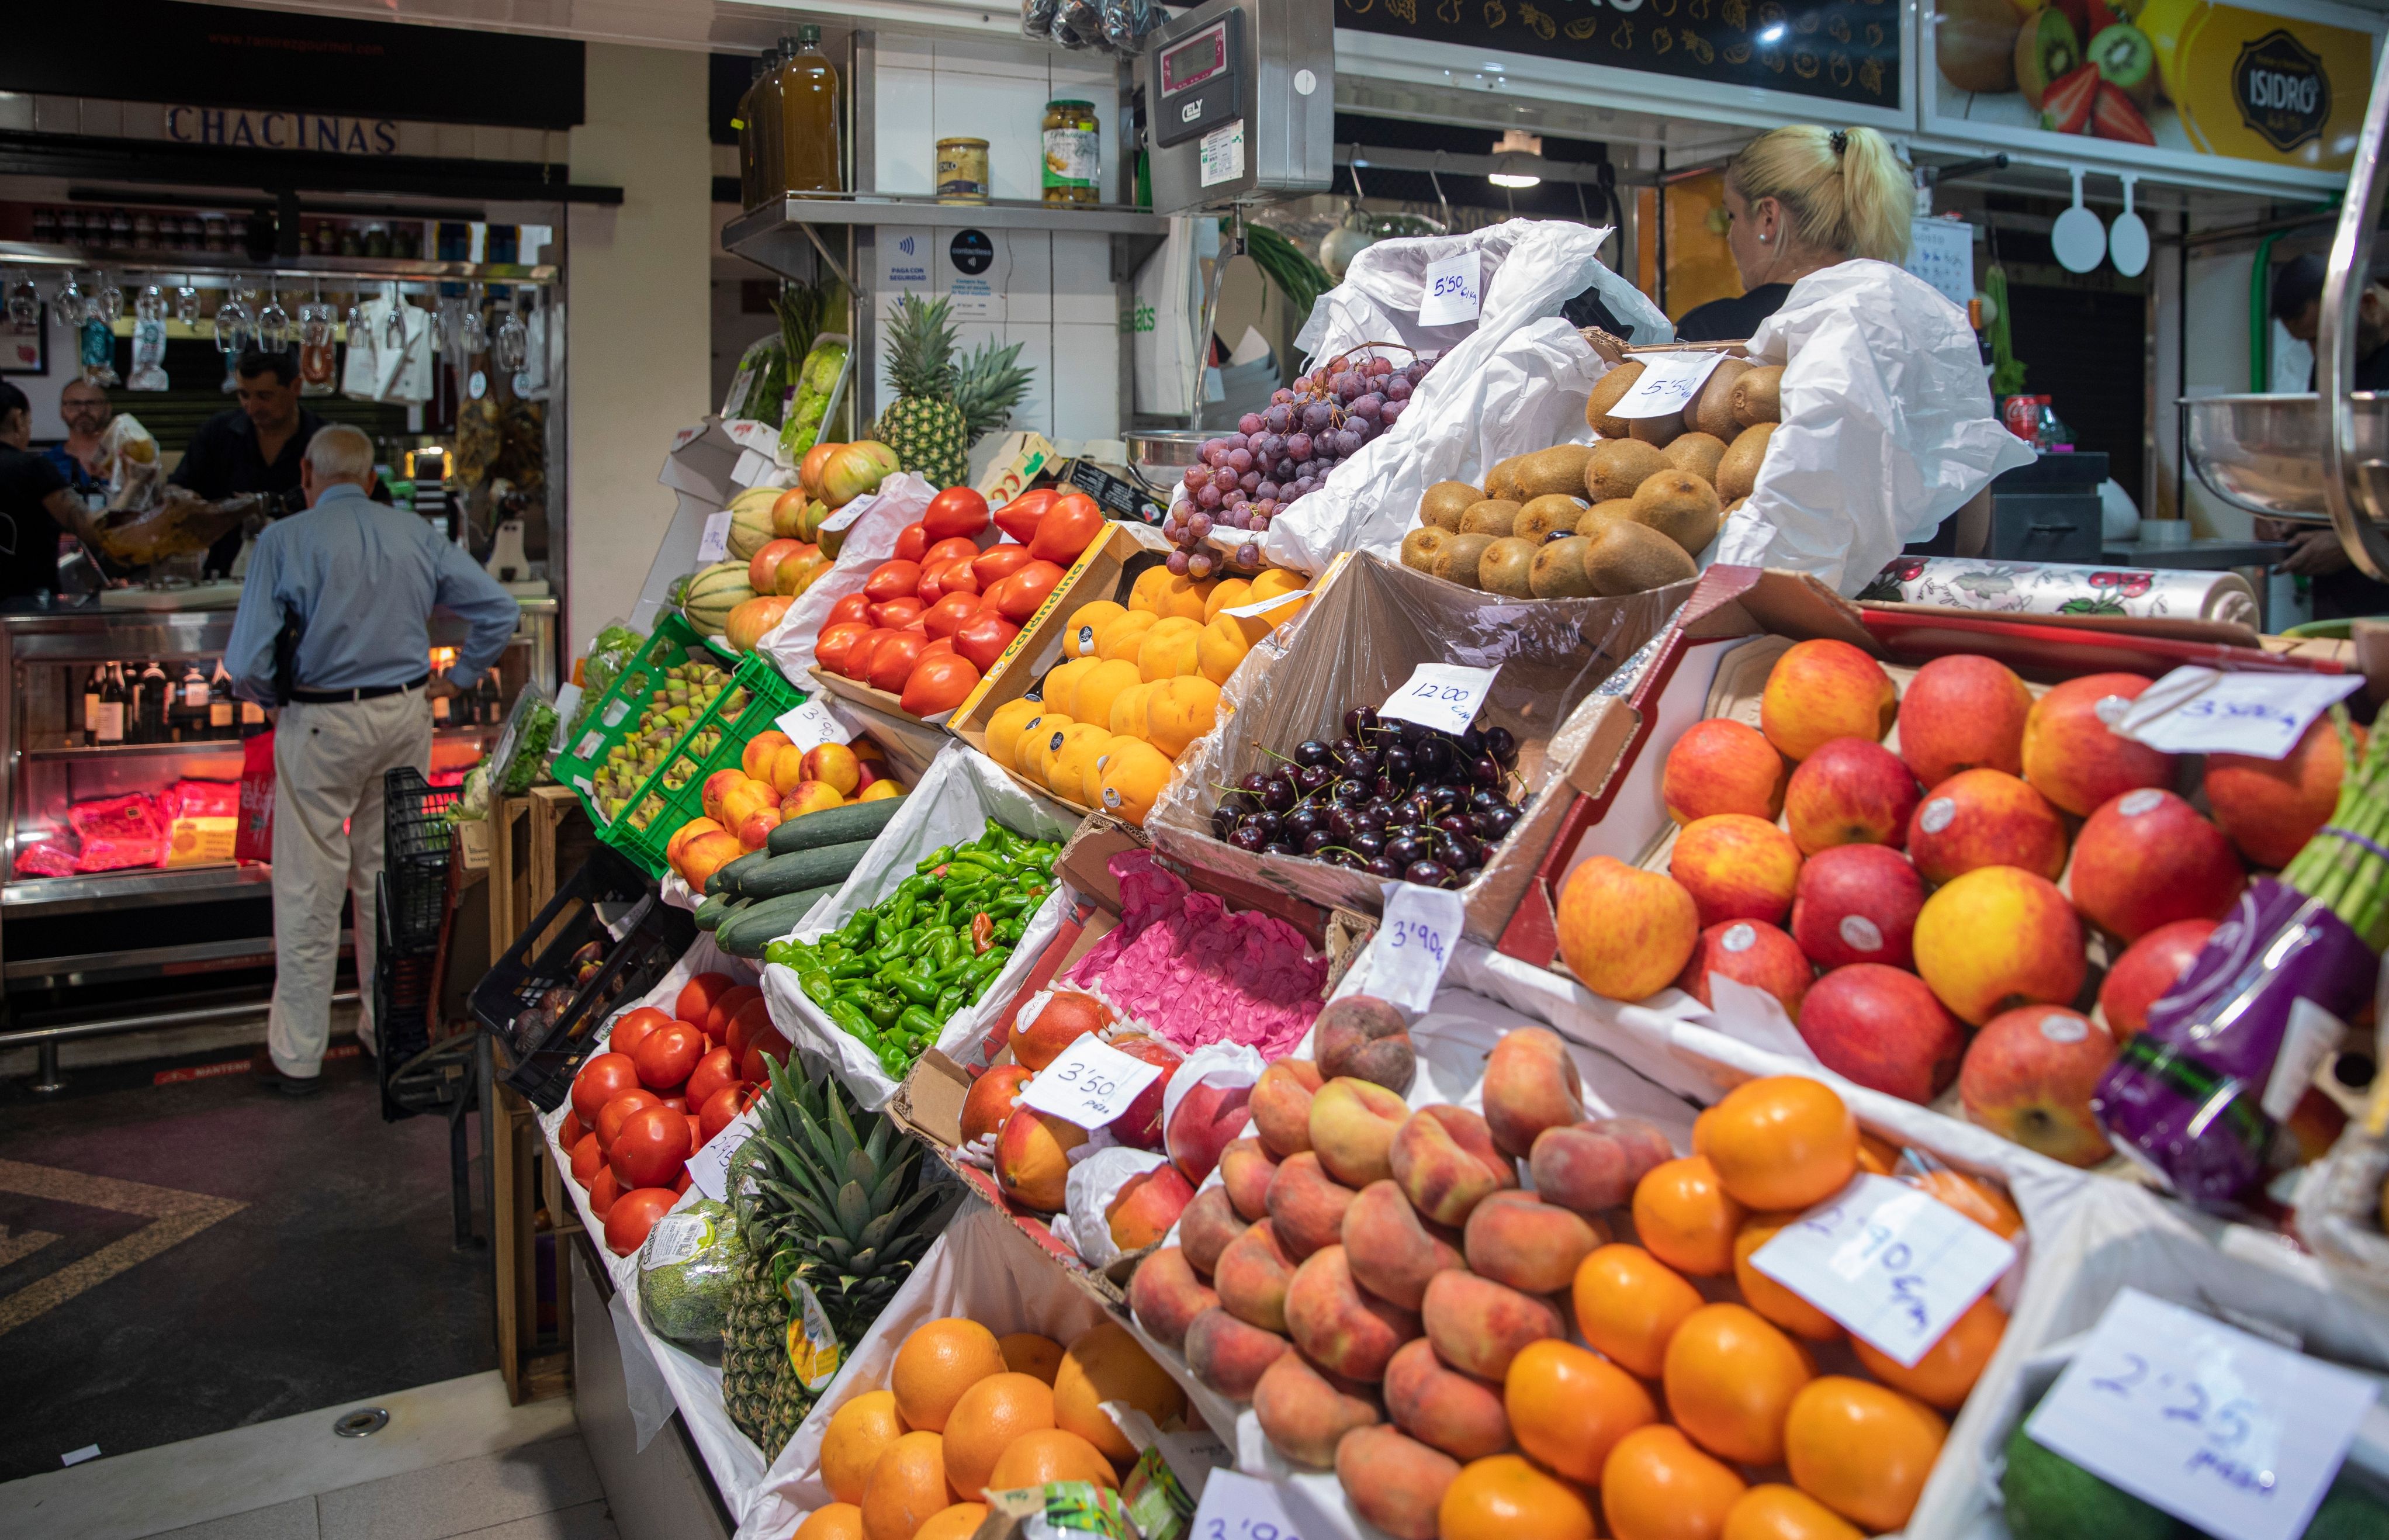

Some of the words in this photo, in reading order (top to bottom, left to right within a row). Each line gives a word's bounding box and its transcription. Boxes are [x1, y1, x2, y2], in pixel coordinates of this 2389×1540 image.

[2250, 69, 2319, 115] ISIDRO
[1182, 98, 1203, 123] CELY
[169, 106, 396, 154] CHACINAS
[1434, 275, 1463, 297] 5'50
[1005, 564, 1084, 656] Calandina
[1412, 683, 1469, 701] 12'00
[195, 1061, 251, 1077] MANTENG
[1058, 1063, 1114, 1095] 3'50
